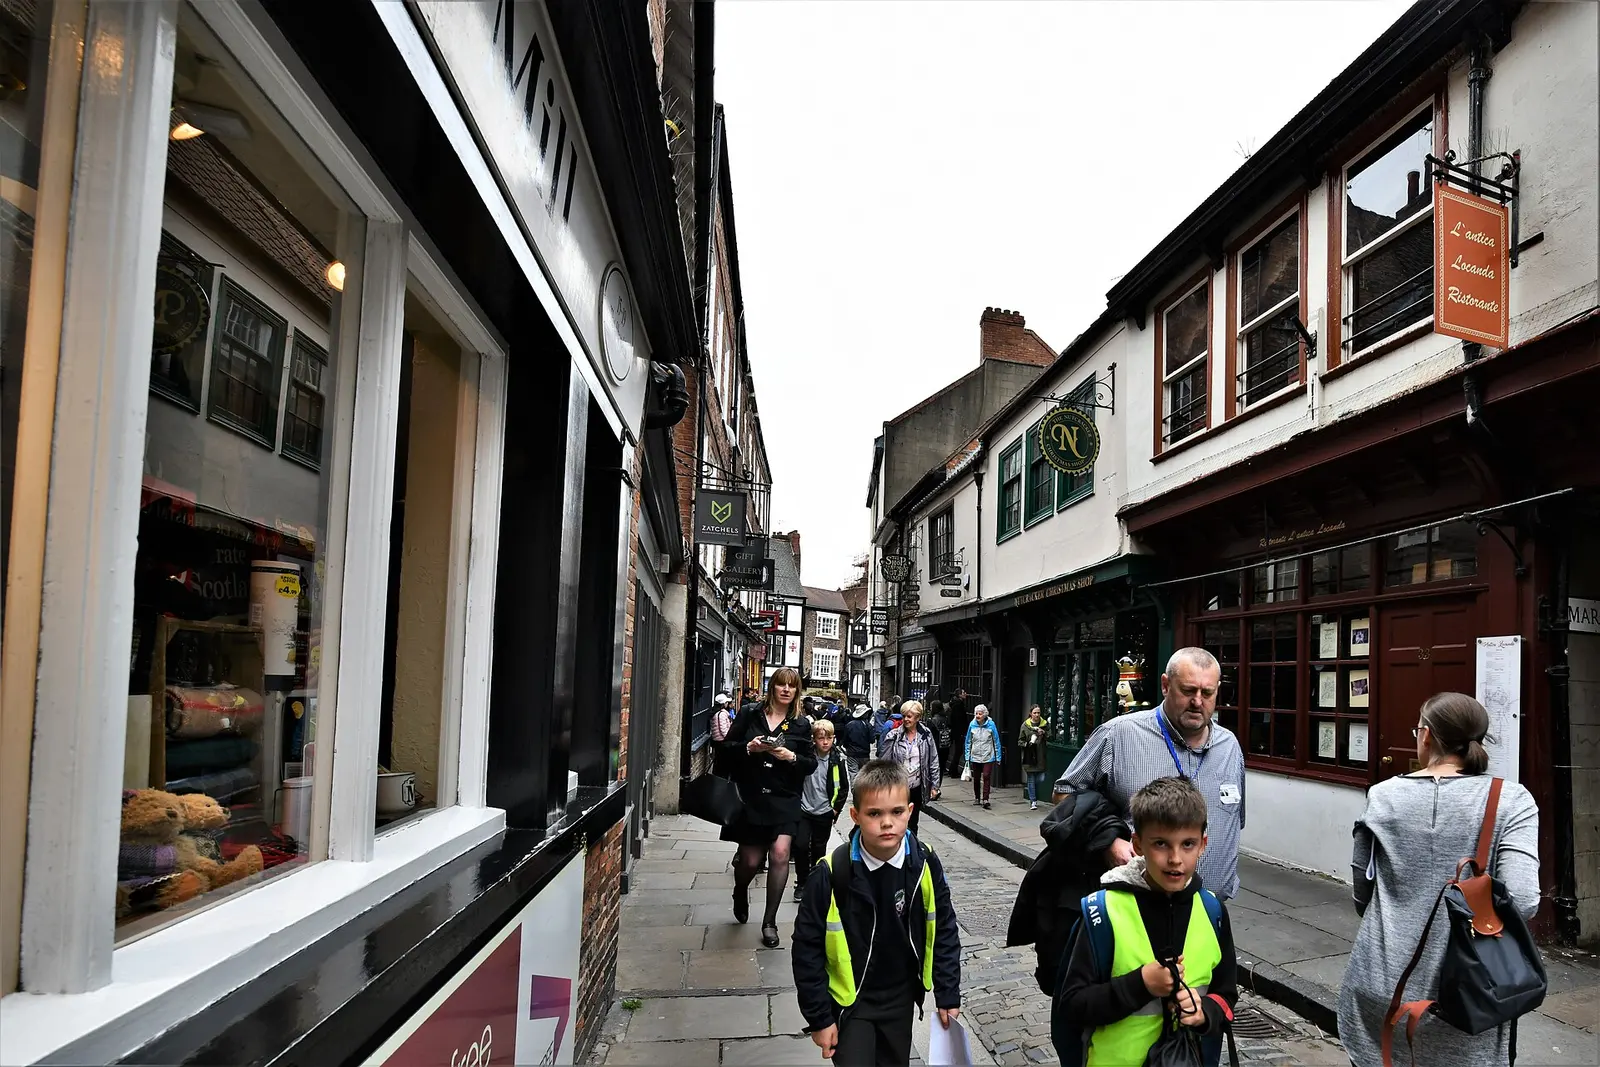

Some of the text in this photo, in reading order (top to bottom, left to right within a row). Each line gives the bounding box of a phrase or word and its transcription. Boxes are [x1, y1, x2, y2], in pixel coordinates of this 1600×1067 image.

[1450, 254, 1496, 280] Locanda
[1447, 286, 1499, 313] Ristorante
[1051, 423, 1088, 459] N
[701, 525, 739, 534] ZATCHELS
[735, 552, 756, 561] GIFT
[724, 565, 763, 575] GALLERY
[1046, 581, 1077, 598] CHRISTMAS
[1077, 575, 1094, 588] SHOP
[1088, 905, 1102, 927] AIR
